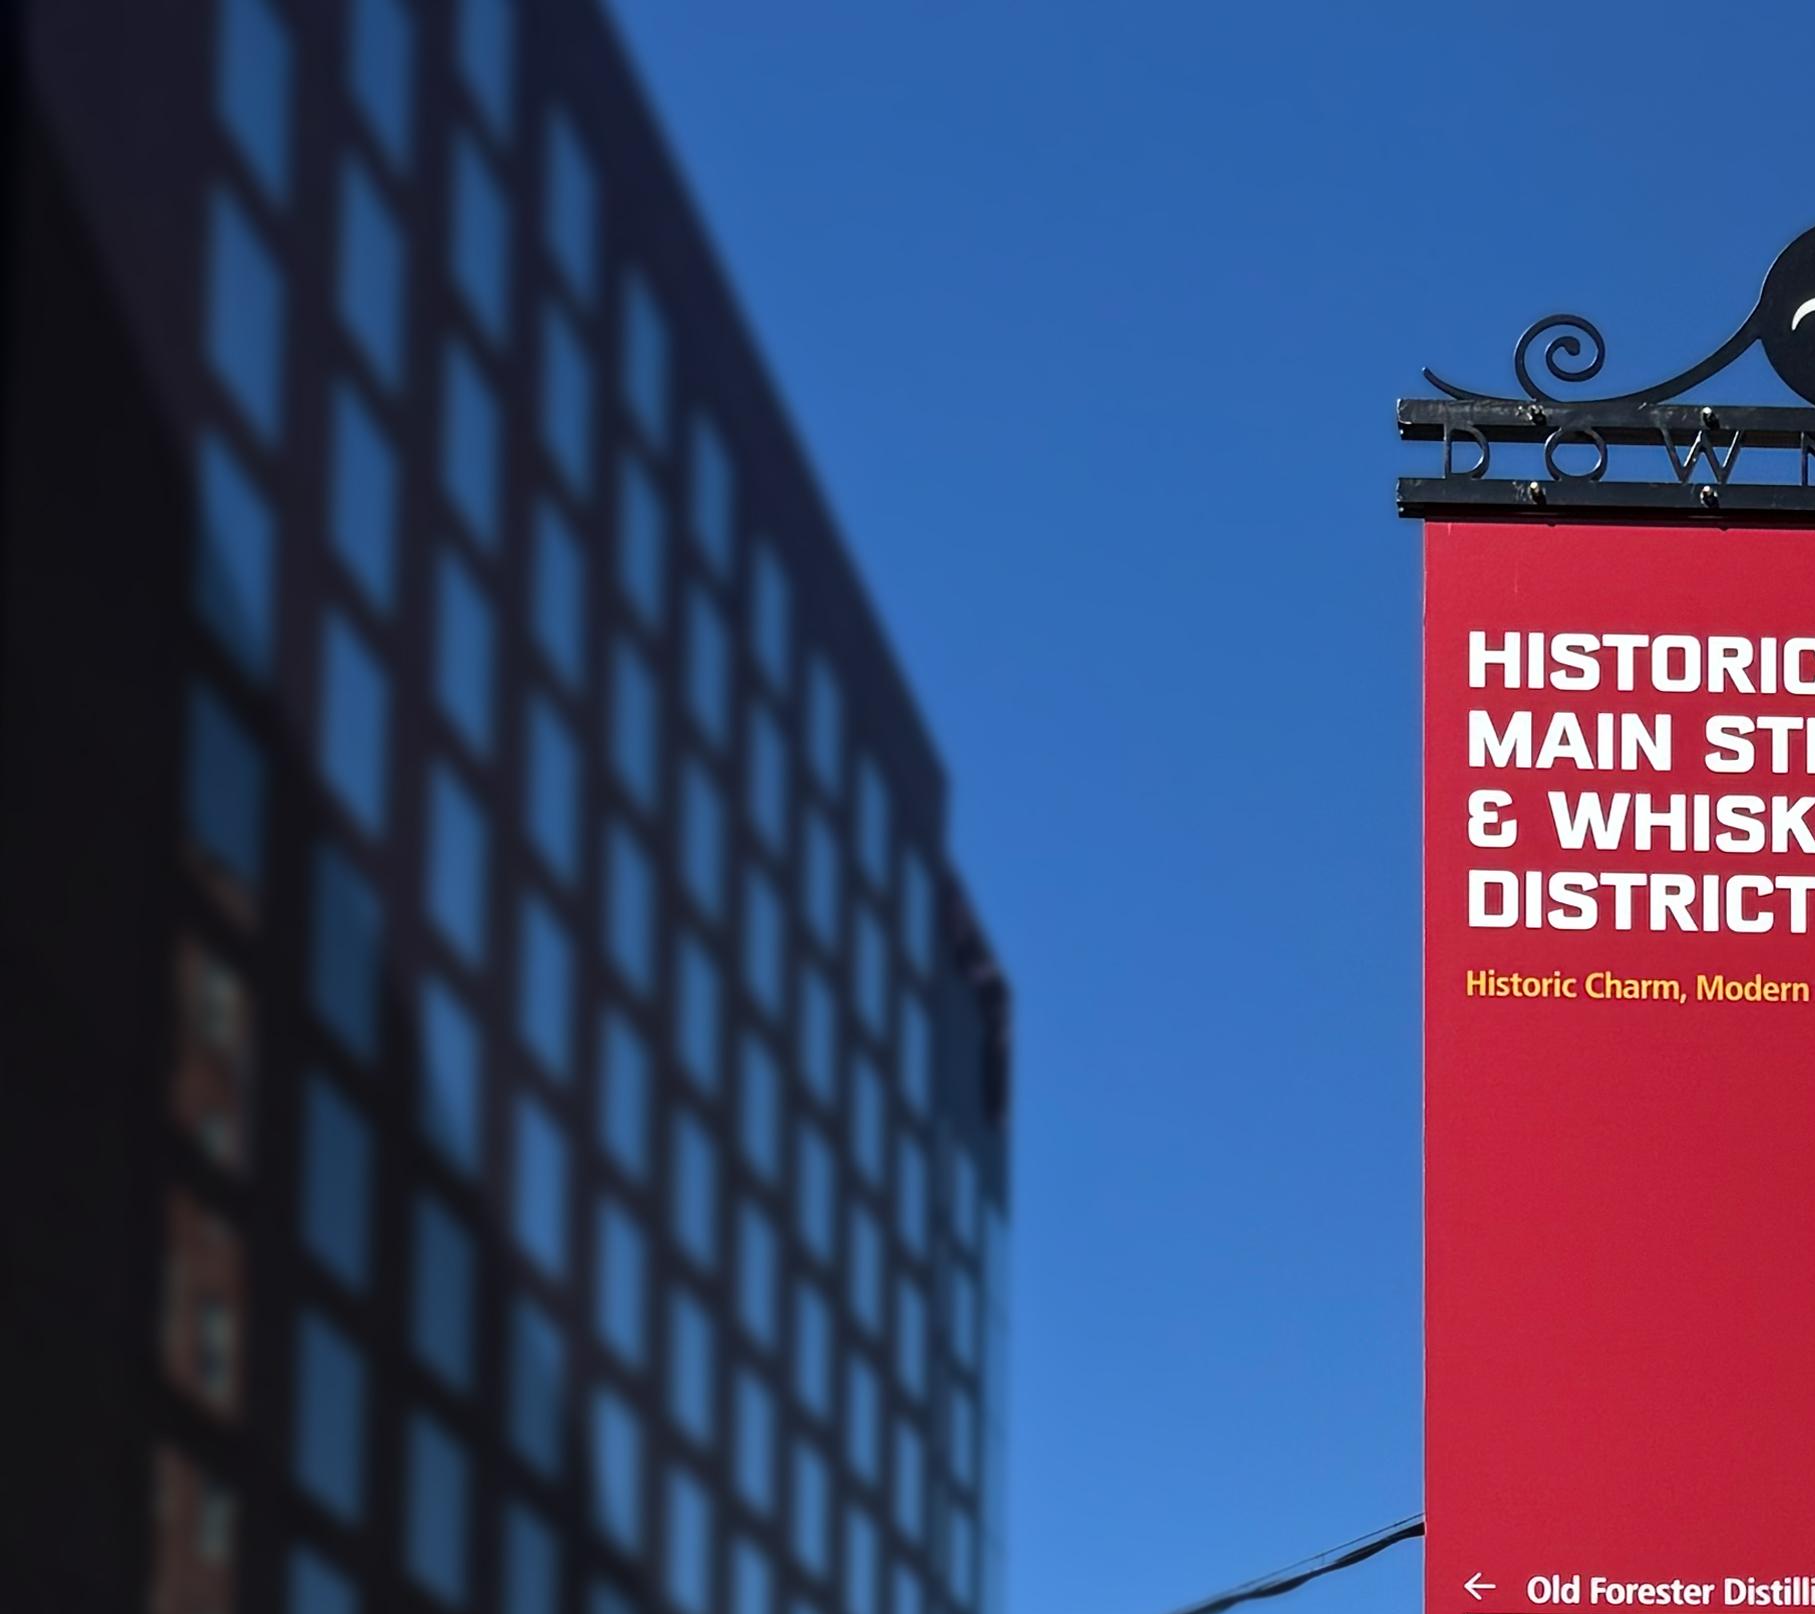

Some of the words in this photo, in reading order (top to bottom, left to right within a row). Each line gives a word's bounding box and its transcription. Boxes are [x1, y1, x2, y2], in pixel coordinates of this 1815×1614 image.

[1467, 708, 1673, 773] MAIN
[1466, 787, 1518, 849] &
[1465, 968, 1577, 999] Historic
[1584, 970, 1687, 1004] Charm,
[1696, 972, 1810, 1002] Modern
[1527, 1574, 1581, 1604] Old
[1590, 1576, 1716, 1606] Forester
